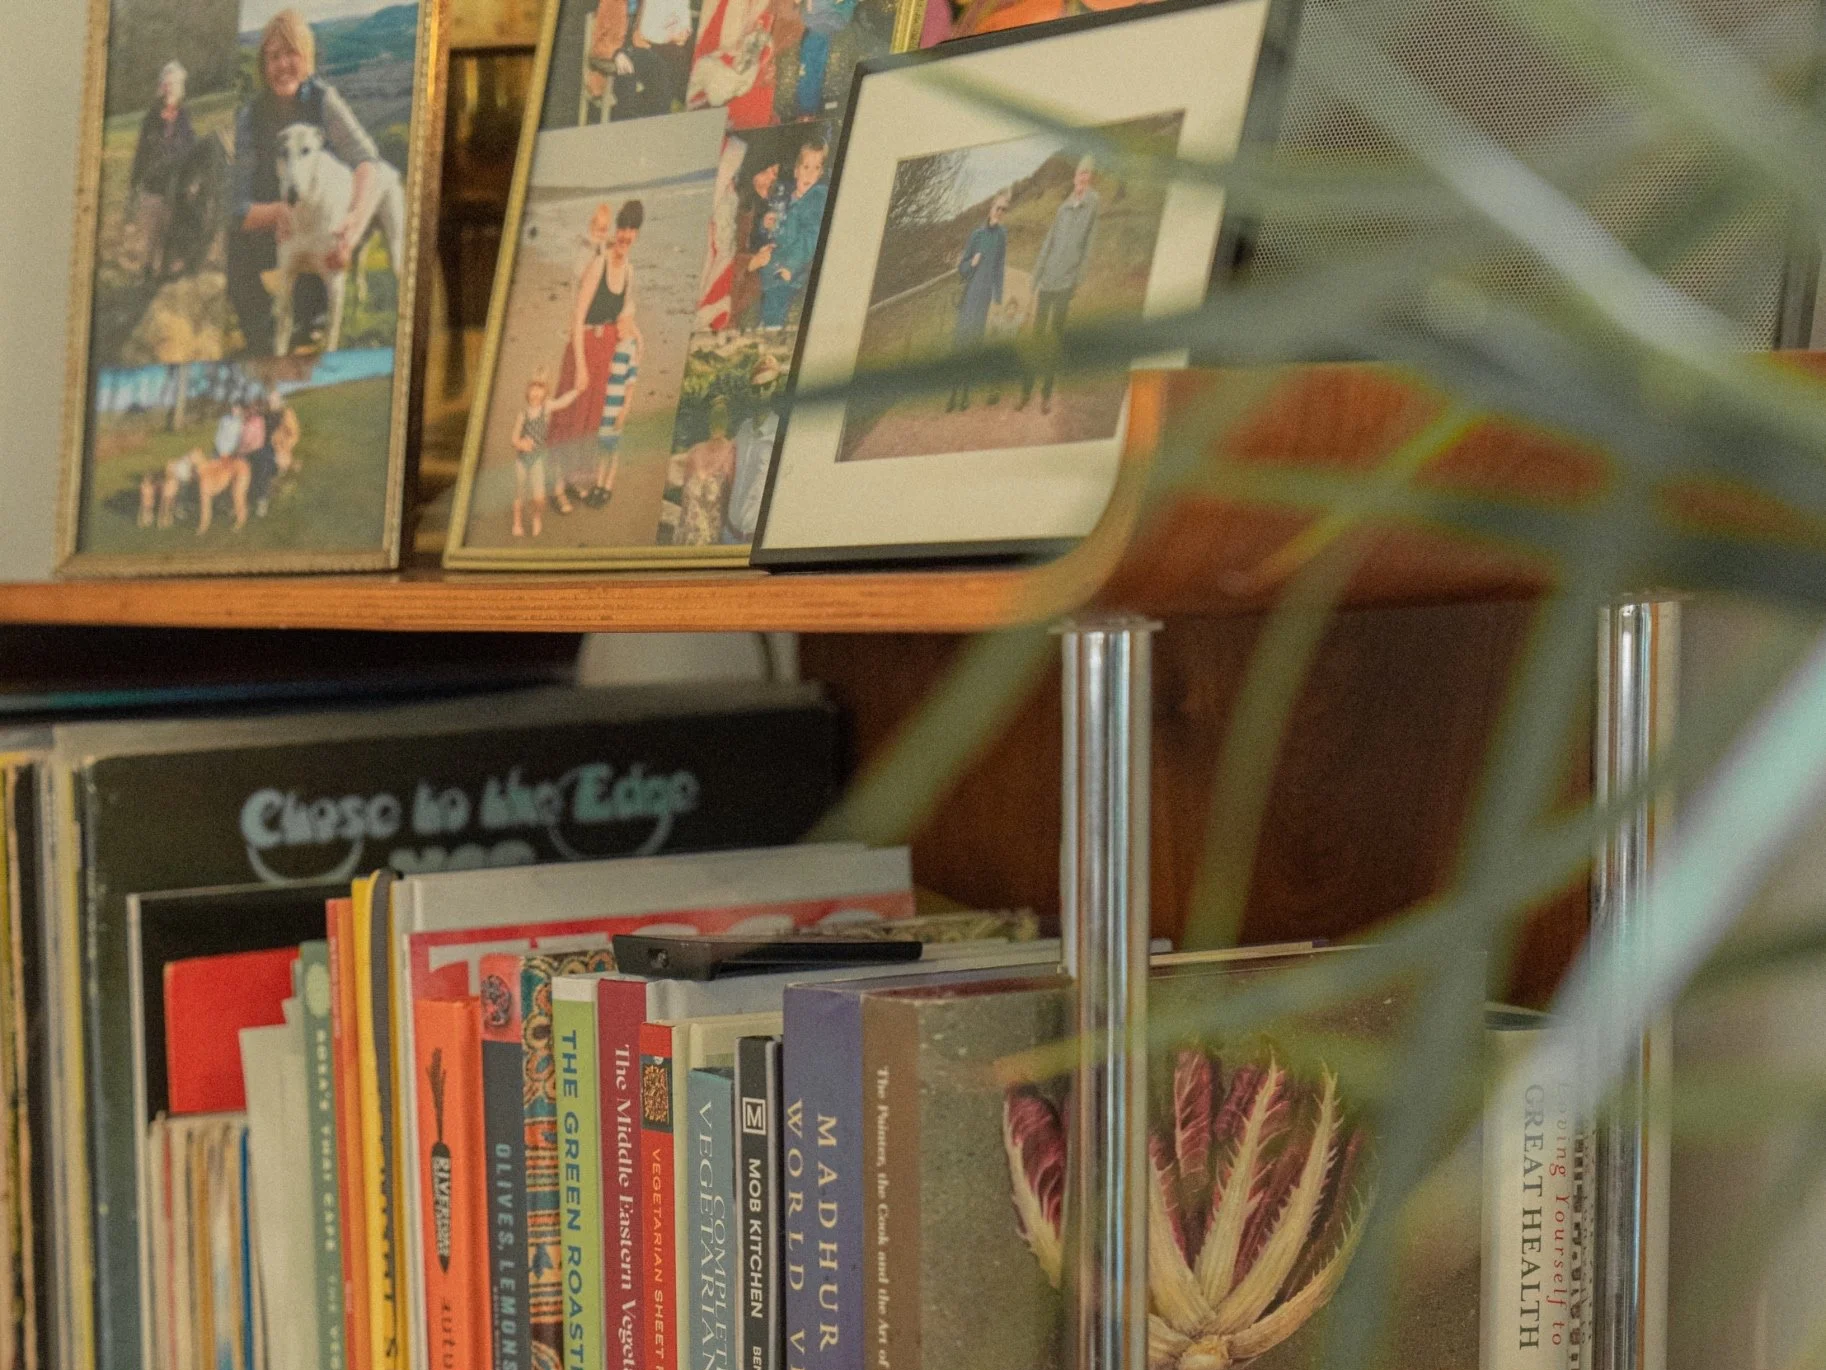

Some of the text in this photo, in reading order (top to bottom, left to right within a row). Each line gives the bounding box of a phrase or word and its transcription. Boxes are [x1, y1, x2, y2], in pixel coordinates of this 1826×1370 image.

[239, 763, 698, 847] Close to the Edge
[562, 1030, 578, 1097] THE
[614, 1044, 631, 1089] The
[877, 1067, 890, 1098] The
[616, 1098, 634, 1188] Middle
[876, 1105, 890, 1167] Painter,
[495, 1144, 513, 1250] OLIVES,
[563, 1112, 582, 1231] GREEN
[787, 1098, 805, 1292] WORLD
[877, 1173, 890, 1199] the
[618, 1195, 636, 1290] Eastern
[652, 1148, 664, 1282] VEGETARIAN
[749, 1158, 763, 1319] MOB KITCHEN
[816, 1113, 839, 1352] MADHUR
[877, 1204, 890, 1245] Cook
[1519, 1085, 1545, 1350] GREAT HEALTH
[878, 1252, 890, 1284] and
[1546, 1194, 1570, 1309] Yourself
[654, 1290, 665, 1357] SHEET
[878, 1288, 891, 1314] the
[878, 1318, 891, 1345] Art
[1552, 1323, 1566, 1345] to
[878, 1350, 891, 1367] of
